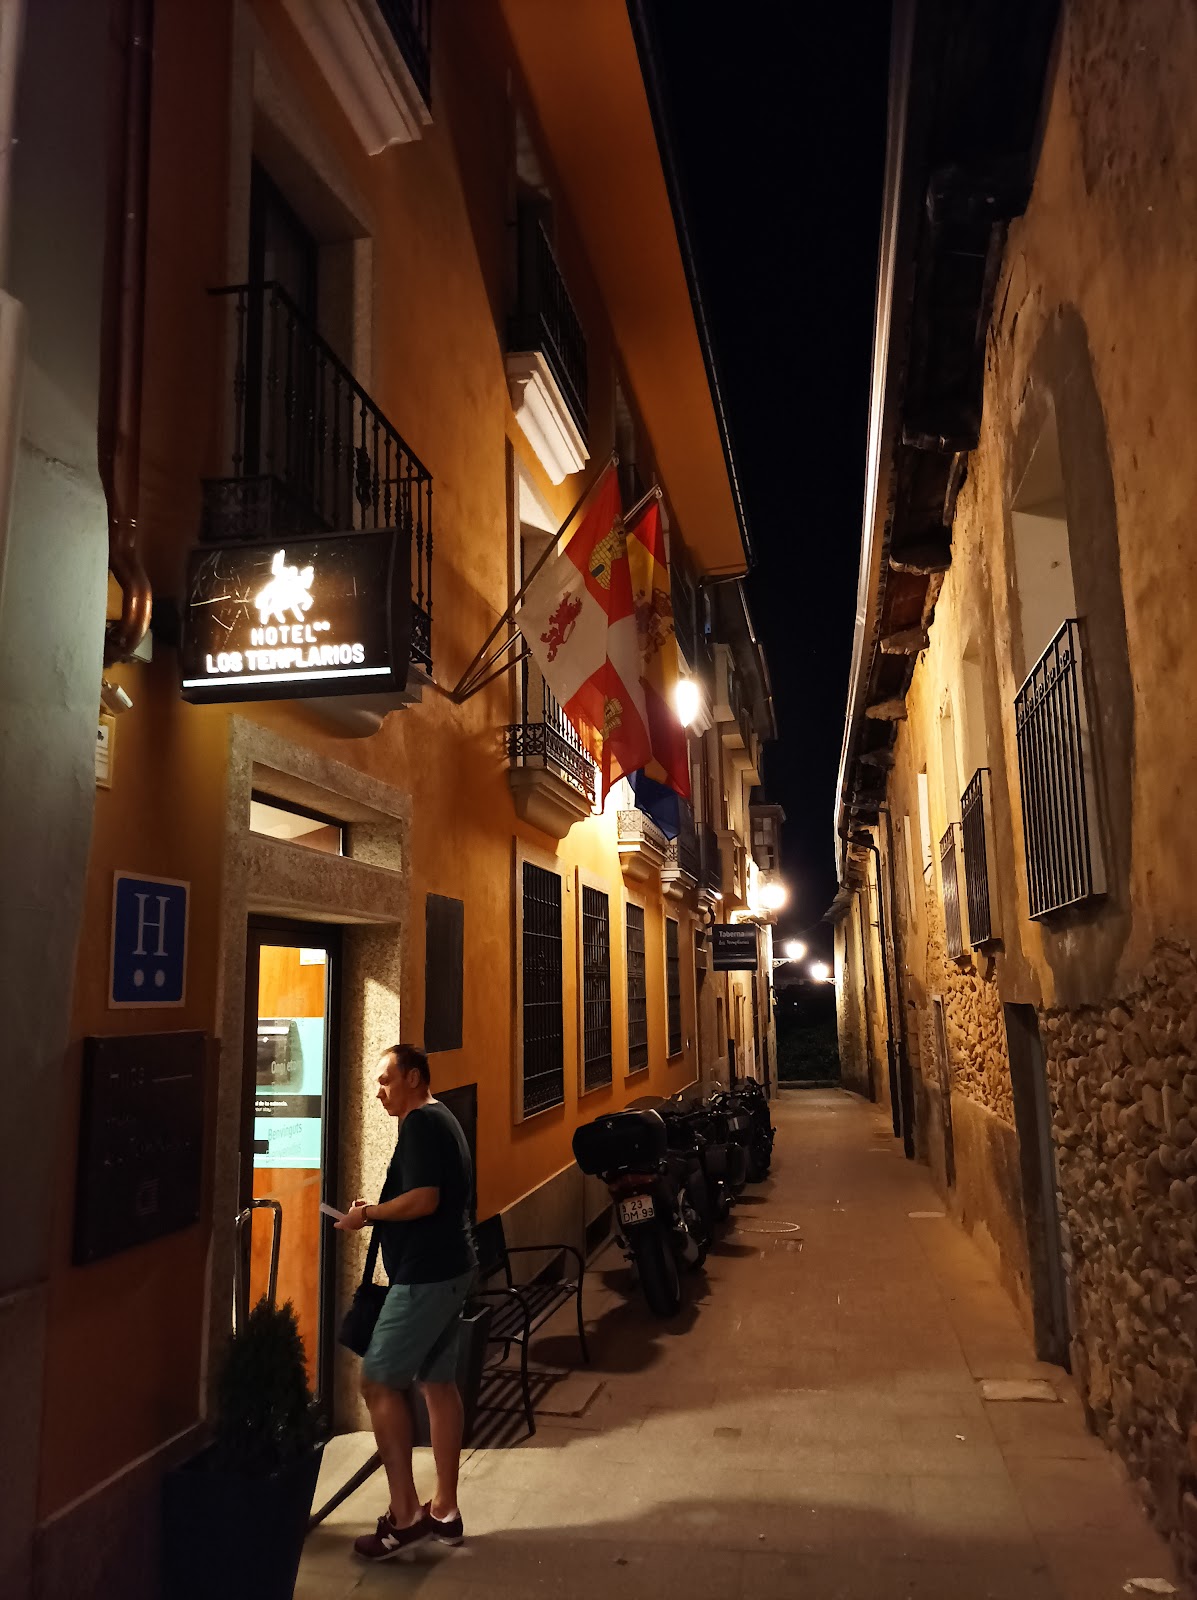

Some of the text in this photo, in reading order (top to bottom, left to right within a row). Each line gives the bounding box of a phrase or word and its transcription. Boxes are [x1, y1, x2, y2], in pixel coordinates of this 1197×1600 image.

[250, 624, 317, 647] HOTEL
[206, 643, 365, 674] LOS TEMPLARIOS
[132, 892, 171, 957] H
[718, 930, 745, 938] Taberna
[631, 1200, 642, 1210] 23
[642, 1208, 653, 1217] 93
